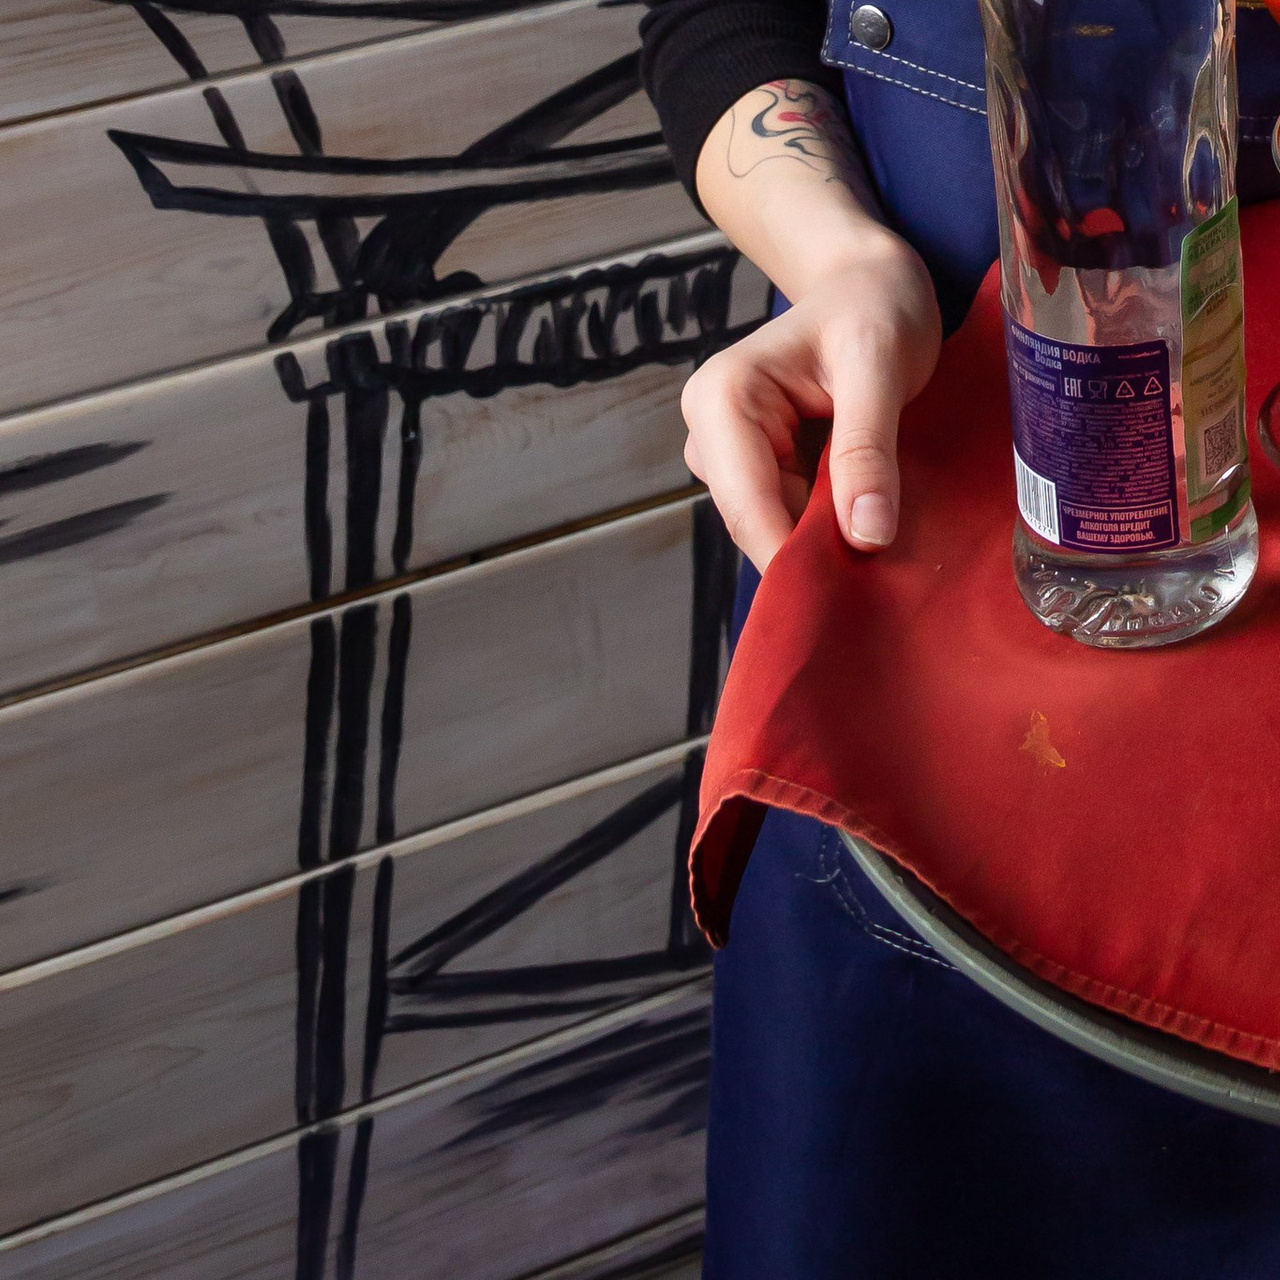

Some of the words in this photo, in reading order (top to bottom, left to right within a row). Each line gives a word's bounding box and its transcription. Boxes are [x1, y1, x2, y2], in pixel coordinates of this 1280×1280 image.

[1010, 324, 1061, 359] ФИНЛЯНДИЯ
[1062, 348, 1101, 365] ВОДКА
[1034, 350, 1062, 370] Водка
[1062, 504, 1109, 521] ЧРЕЗМЕРНОЕ
[1109, 504, 1169, 521] УПОТРЕБЛЕНИЕ
[1079, 520, 1120, 532] АЛКОГОЛЯ
[1120, 519, 1151, 533] ВРЕДИТ
[1076, 530, 1109, 543] ВАШЕМУ
[1109, 530, 1156, 545] ЗДОРОВЬЮ.
